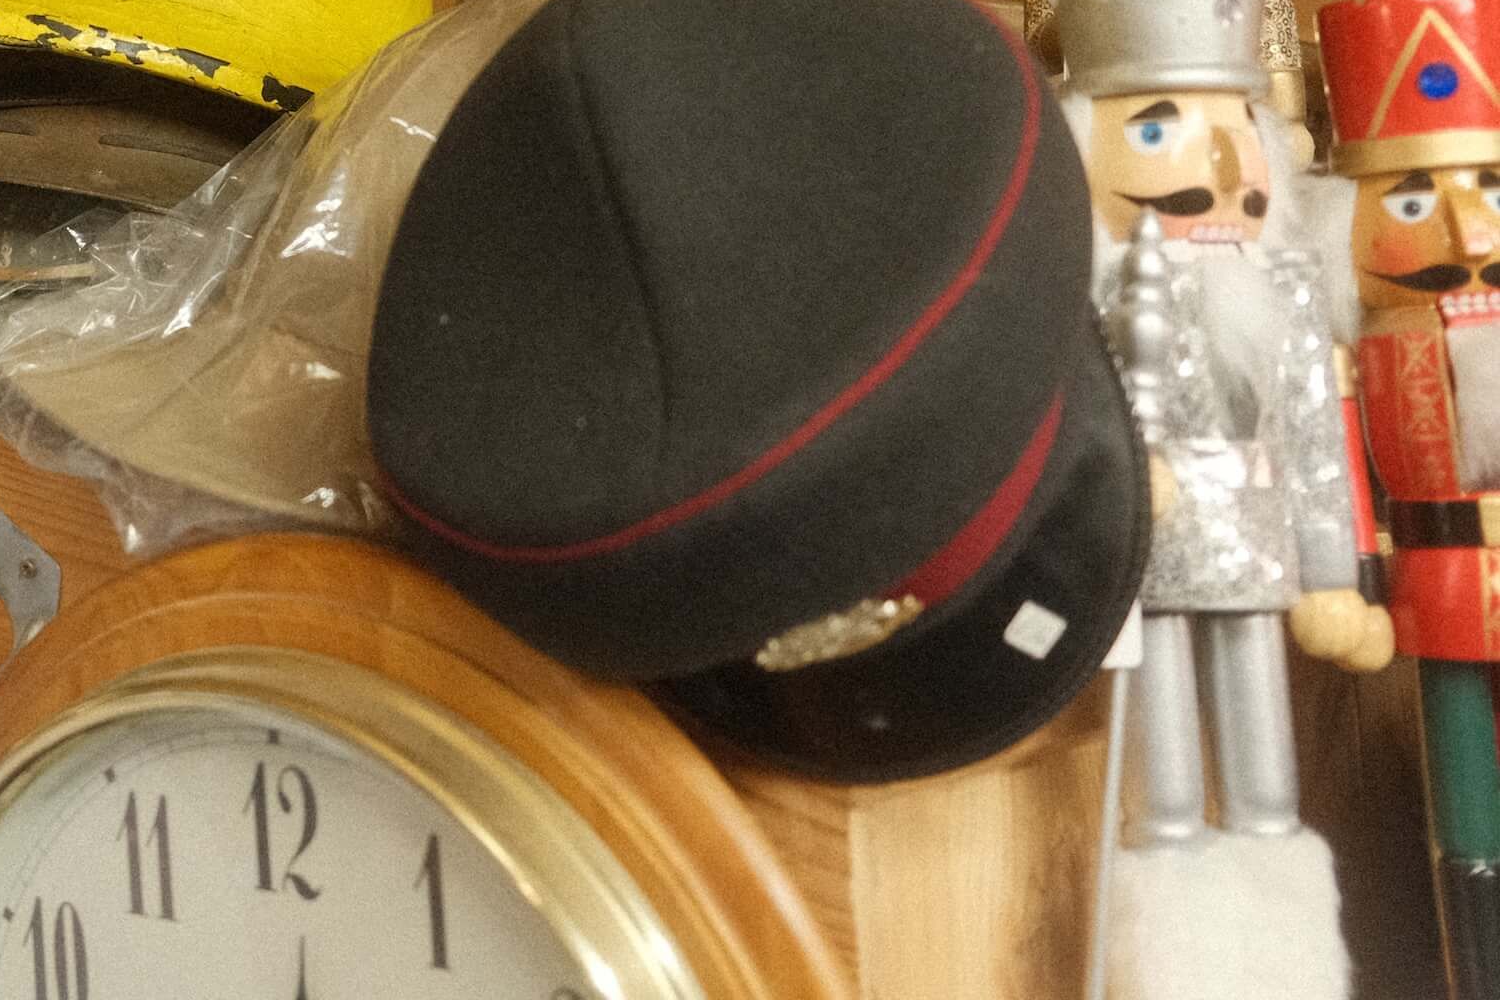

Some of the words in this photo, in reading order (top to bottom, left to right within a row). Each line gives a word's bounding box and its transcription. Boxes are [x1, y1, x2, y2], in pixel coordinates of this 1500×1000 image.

[116, 790, 176, 921] 11
[243, 761, 321, 901] 12
[22, 896, 89, 1000] 10
[413, 832, 451, 970] 1
